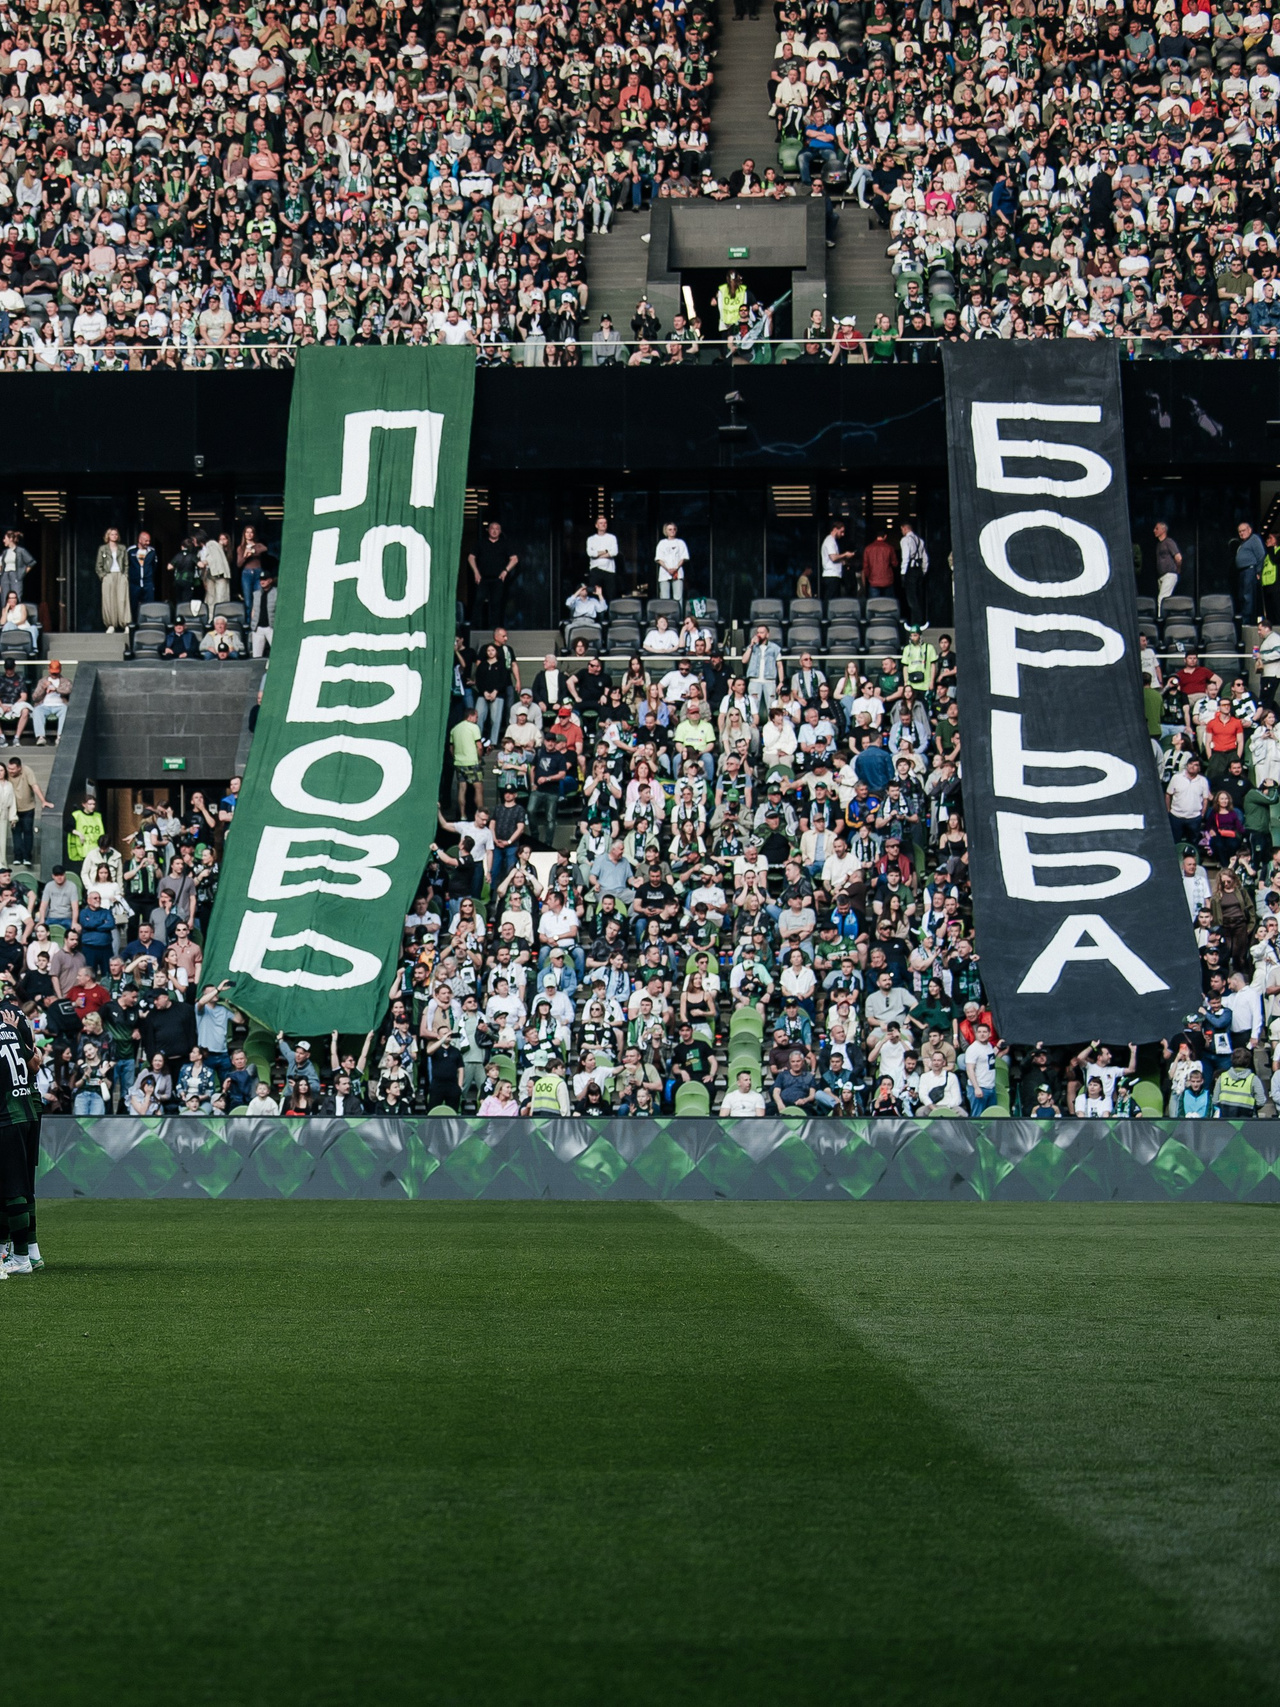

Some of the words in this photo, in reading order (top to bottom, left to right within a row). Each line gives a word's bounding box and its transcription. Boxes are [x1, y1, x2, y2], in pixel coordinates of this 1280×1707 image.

[228, 408, 445, 992] ЛЮБОВЬ
[969, 400, 1171, 996] БОРЬБА
[535, 1082, 554, 1093] 006
[1223, 1076, 1248, 1088] 127
